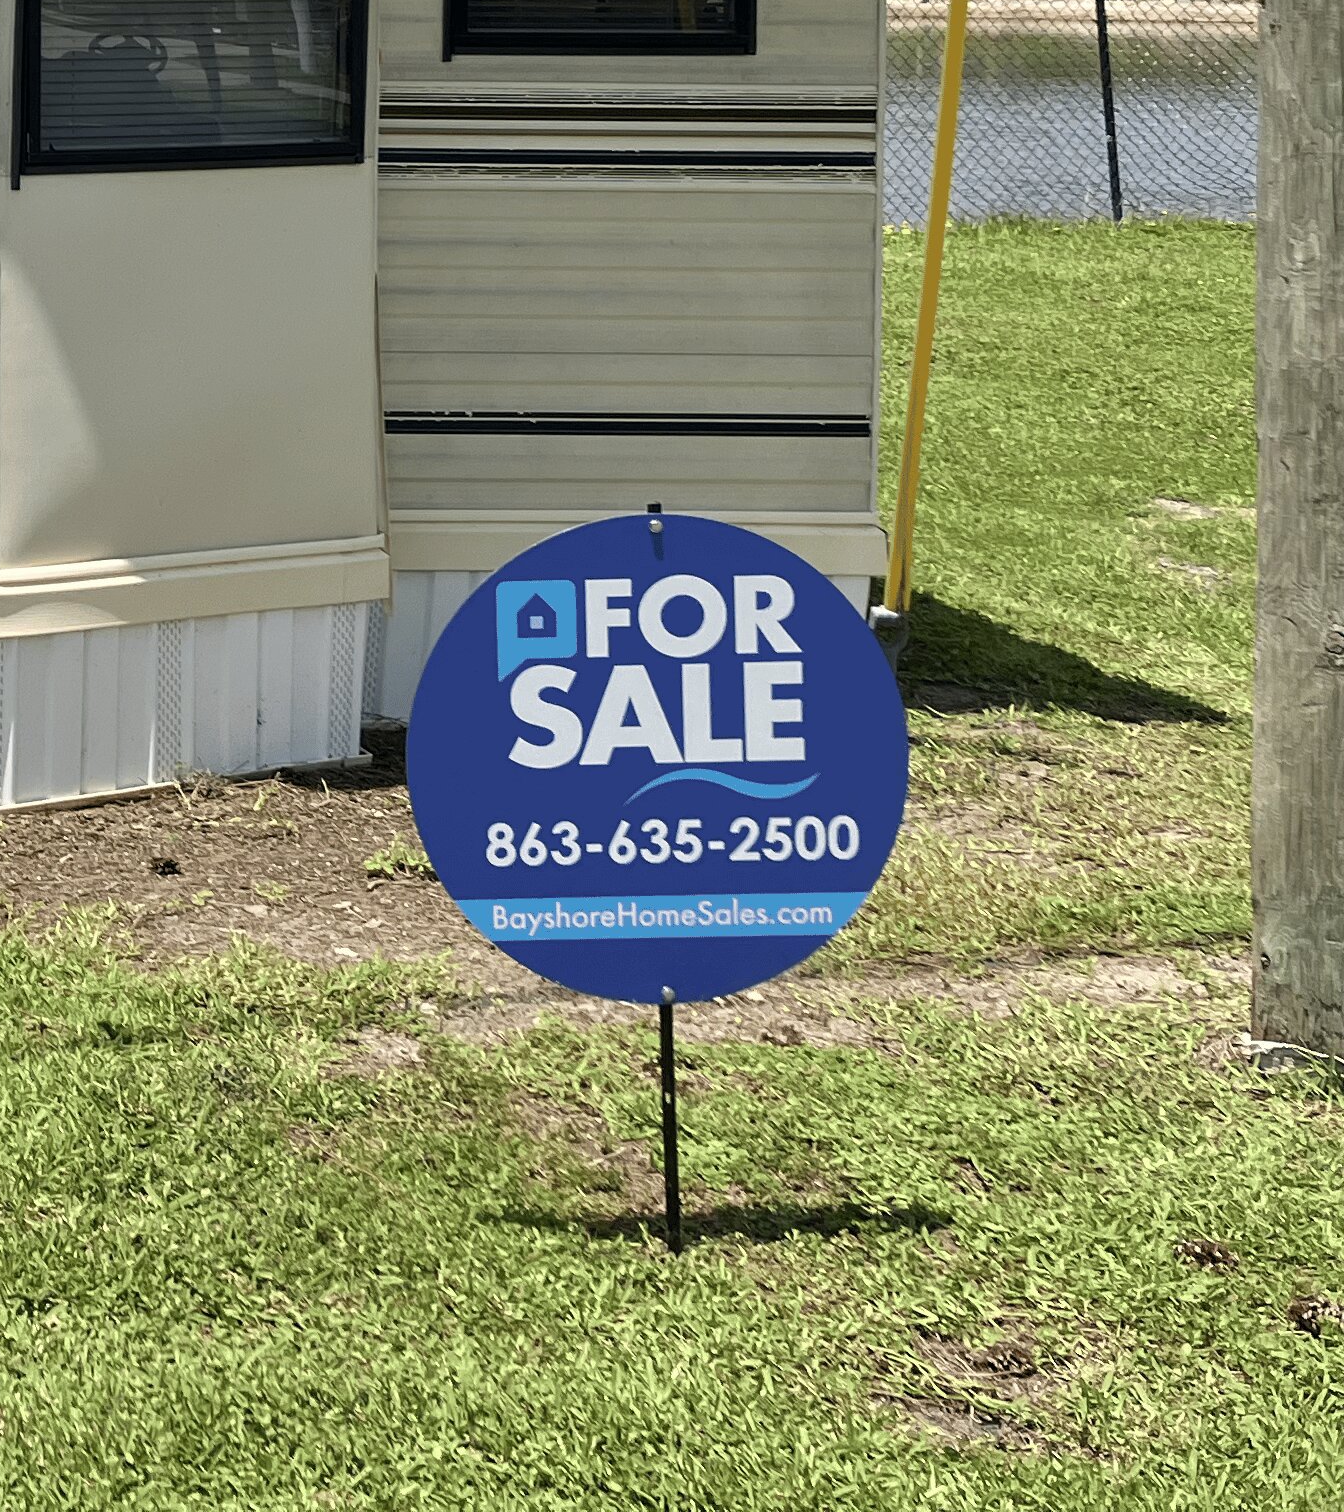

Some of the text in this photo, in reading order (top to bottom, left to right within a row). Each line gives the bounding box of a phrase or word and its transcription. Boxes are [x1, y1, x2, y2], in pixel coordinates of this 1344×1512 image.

[583, 573, 804, 659] FOR
[507, 660, 807, 770] SALE
[485, 814, 861, 868] 863-635-2500
[492, 897, 833, 937] BayshoreHomeSales.com
